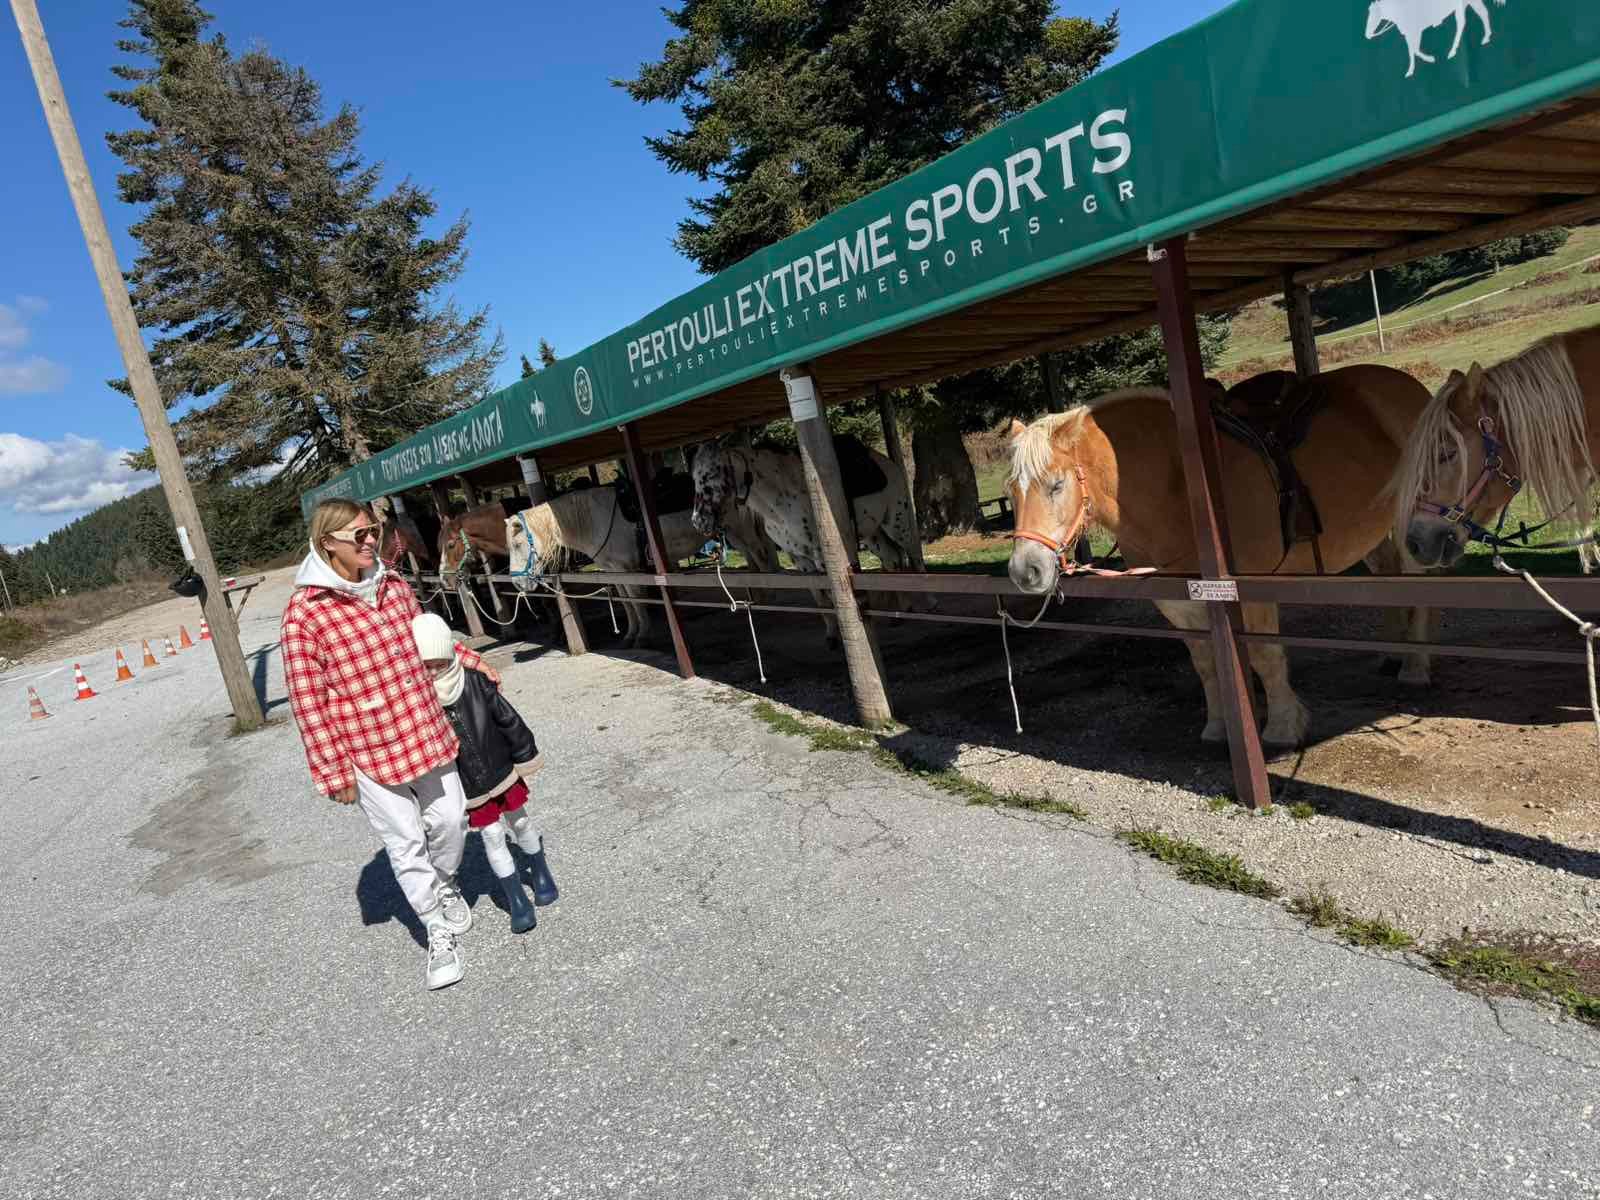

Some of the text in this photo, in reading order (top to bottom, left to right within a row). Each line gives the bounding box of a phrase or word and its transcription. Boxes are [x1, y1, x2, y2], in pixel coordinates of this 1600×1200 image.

[627, 108, 1132, 373] PERTOULI EXTREME SPORTS
[472, 404, 504, 457] ΑΛΟΓΑ
